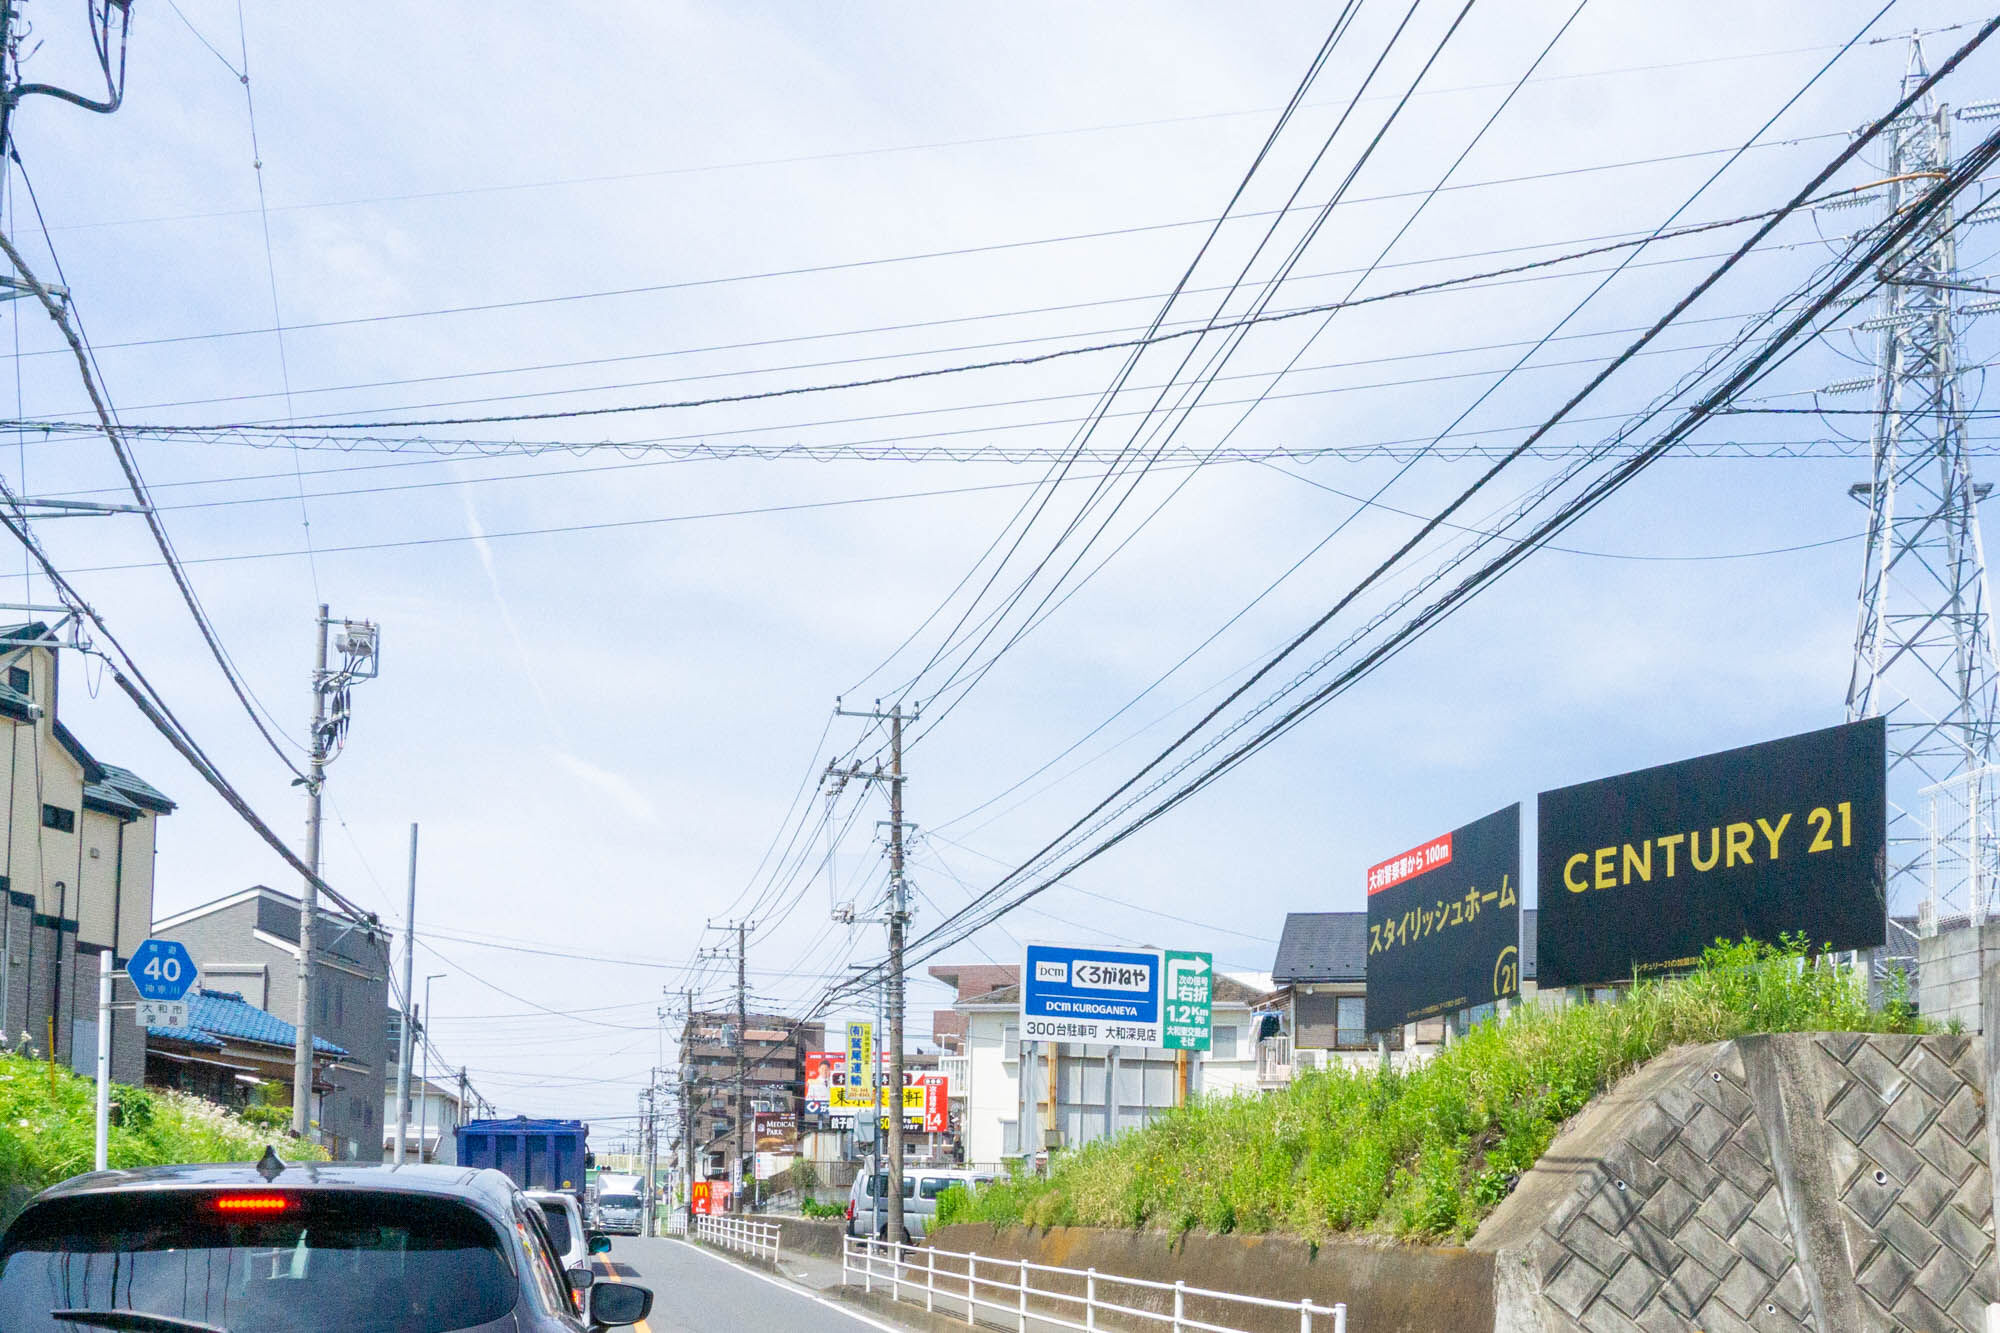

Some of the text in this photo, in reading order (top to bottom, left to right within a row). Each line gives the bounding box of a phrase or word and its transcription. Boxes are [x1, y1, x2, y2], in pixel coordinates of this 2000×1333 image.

[1563, 802, 1853, 893] CENTURY 21
[1368, 843, 1449, 891] 大和警察署から 100m
[1368, 873, 1517, 956] スタイリッシュホーム
[143, 956, 182, 982] 40
[1075, 965, 1147, 987] くろがねや
[1178, 986, 1208, 1003] 右折
[142, 1004, 182, 1014] 大和市
[1072, 1003, 1138, 1016] KUROGANEYA
[1167, 1005, 1191, 1023] 1.2
[1105, 1026, 1157, 1042] 大和深見店
[766, 1120, 795, 1128] MEDICAL
